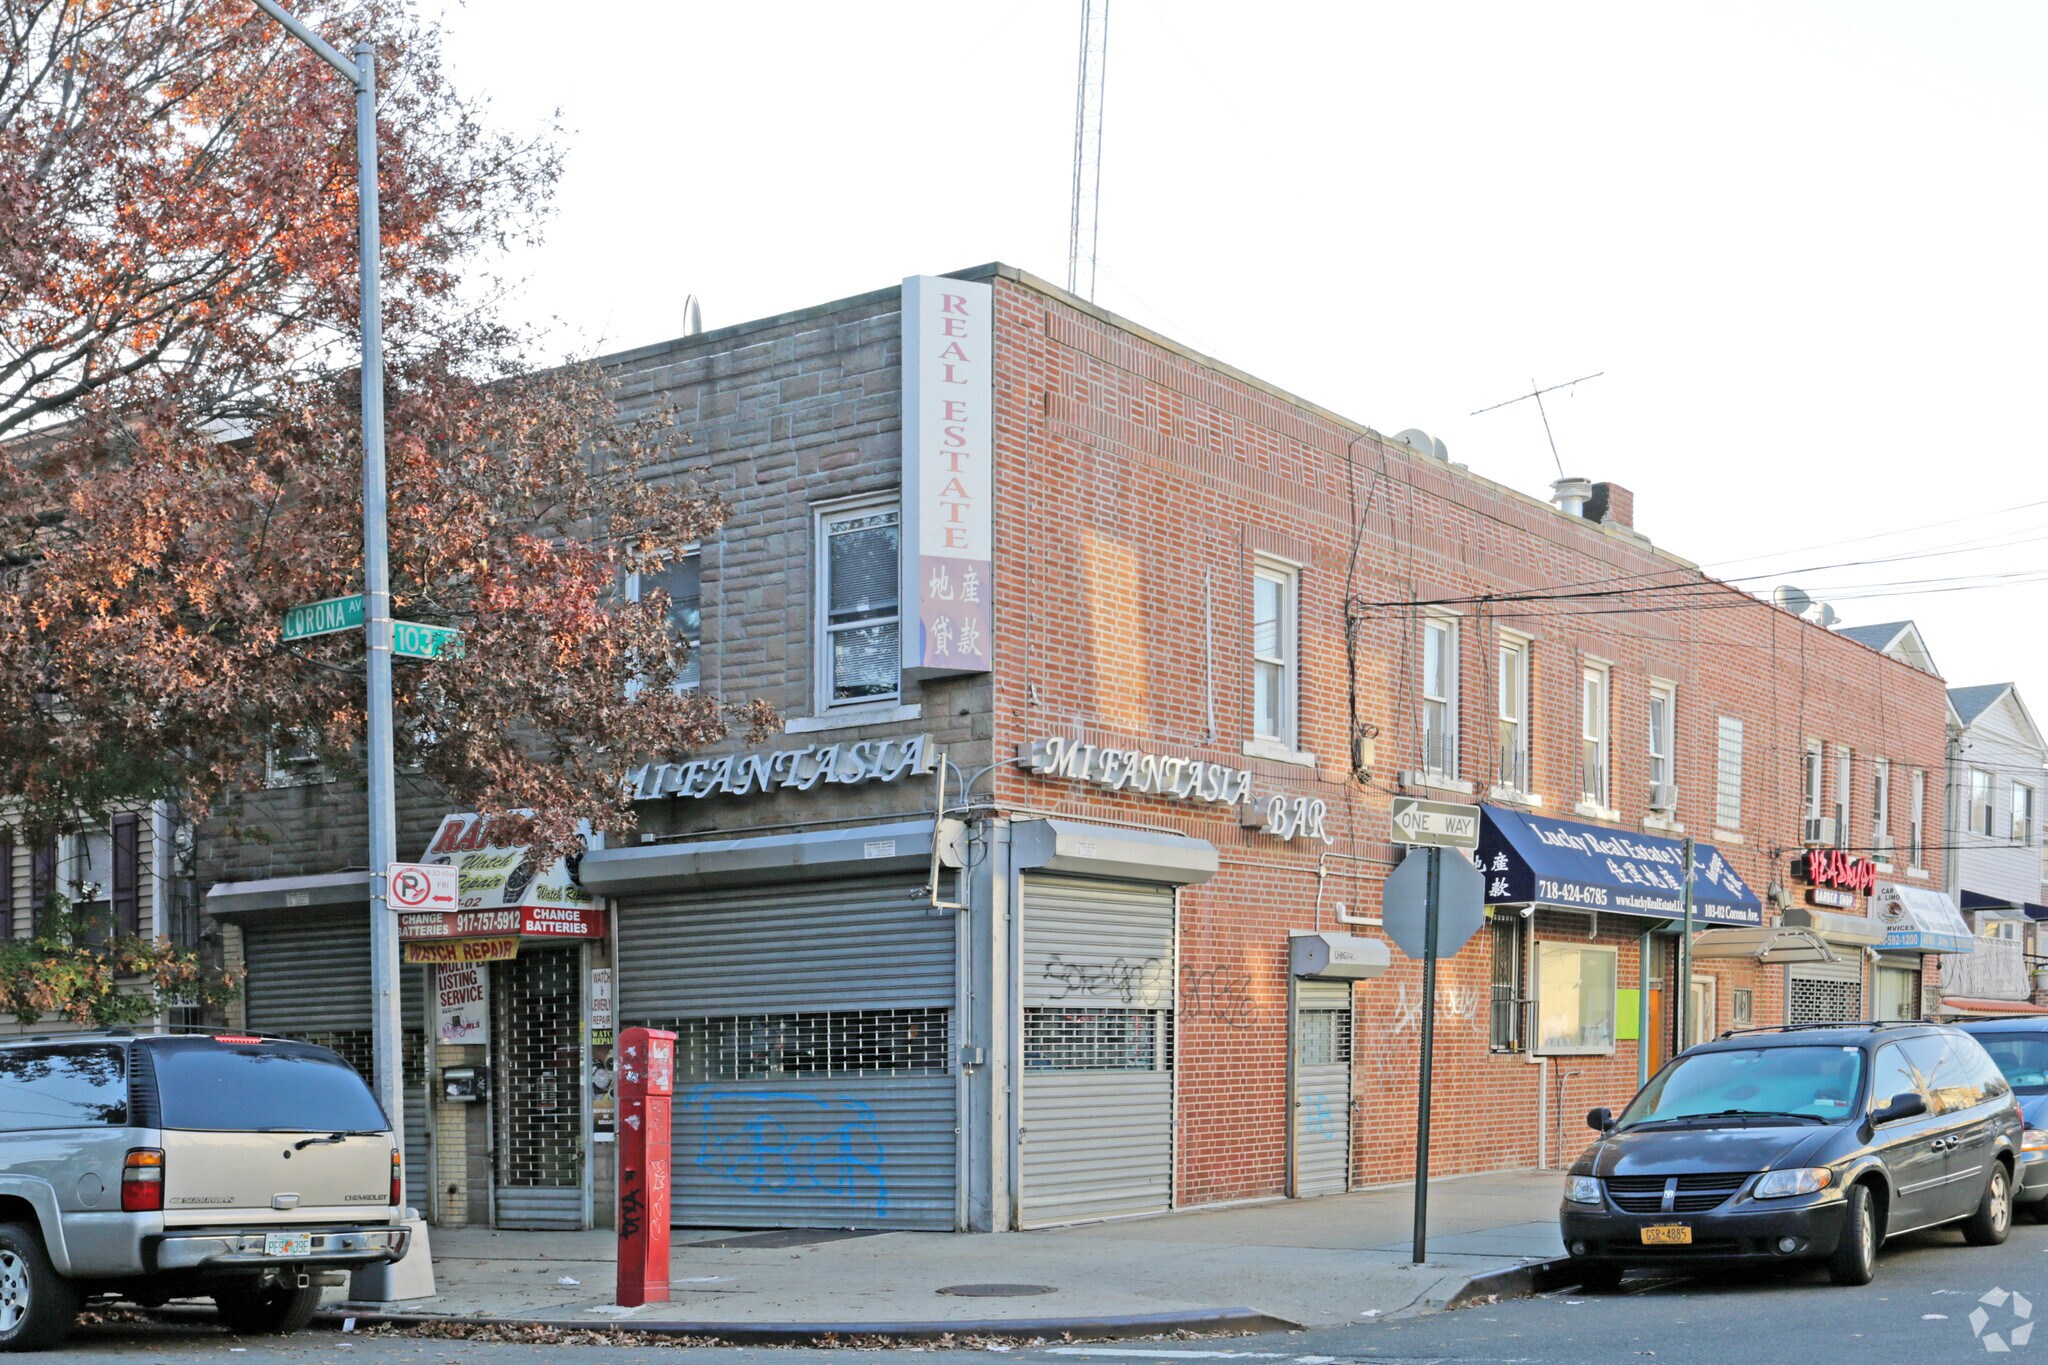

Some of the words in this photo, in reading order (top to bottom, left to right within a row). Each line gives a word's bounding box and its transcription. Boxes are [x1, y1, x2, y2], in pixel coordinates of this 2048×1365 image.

[938, 293, 972, 385] REAL
[938, 399, 972, 550] ESTATE
[285, 602, 346, 637] CORONA
[349, 599, 362, 613] AV
[397, 626, 433, 654] 103
[675, 735, 935, 799] FANTASIA
[1044, 736, 1096, 780] MI
[1099, 748, 1253, 806] FANTASIA
[1266, 794, 1334, 846] BAR
[1401, 812, 1430, 831] ONE
[1445, 817, 1472, 835] WAY
[1529, 823, 1591, 857] Lucky
[1582, 833, 1628, 857] Real
[1622, 837, 1676, 864] Estate
[460, 851, 514, 872] Watch
[1539, 880, 1608, 906] 718-424-6785
[1704, 903, 1725, 919] 103-02
[1725, 905, 1747, 921] Corona
[1814, 888, 1838, 905] BARBER
[1839, 892, 1853, 907] SHOP
[402, 913, 443, 925] CHANGE
[457, 911, 521, 932] 917-757-5912
[533, 908, 581, 921] CHANGE
[526, 920, 588, 934] BATTERIES
[408, 943, 456, 962] WATCH
[463, 941, 513, 960] REPAIR
[439, 970, 478, 991] LISTING
[592, 972, 611, 984] WATCH
[440, 985, 484, 1007] SERVICE
[592, 1015, 611, 1025] REPAIR
[592, 1030, 613, 1038] WATC
[592, 1037, 613, 1046] REPAI
